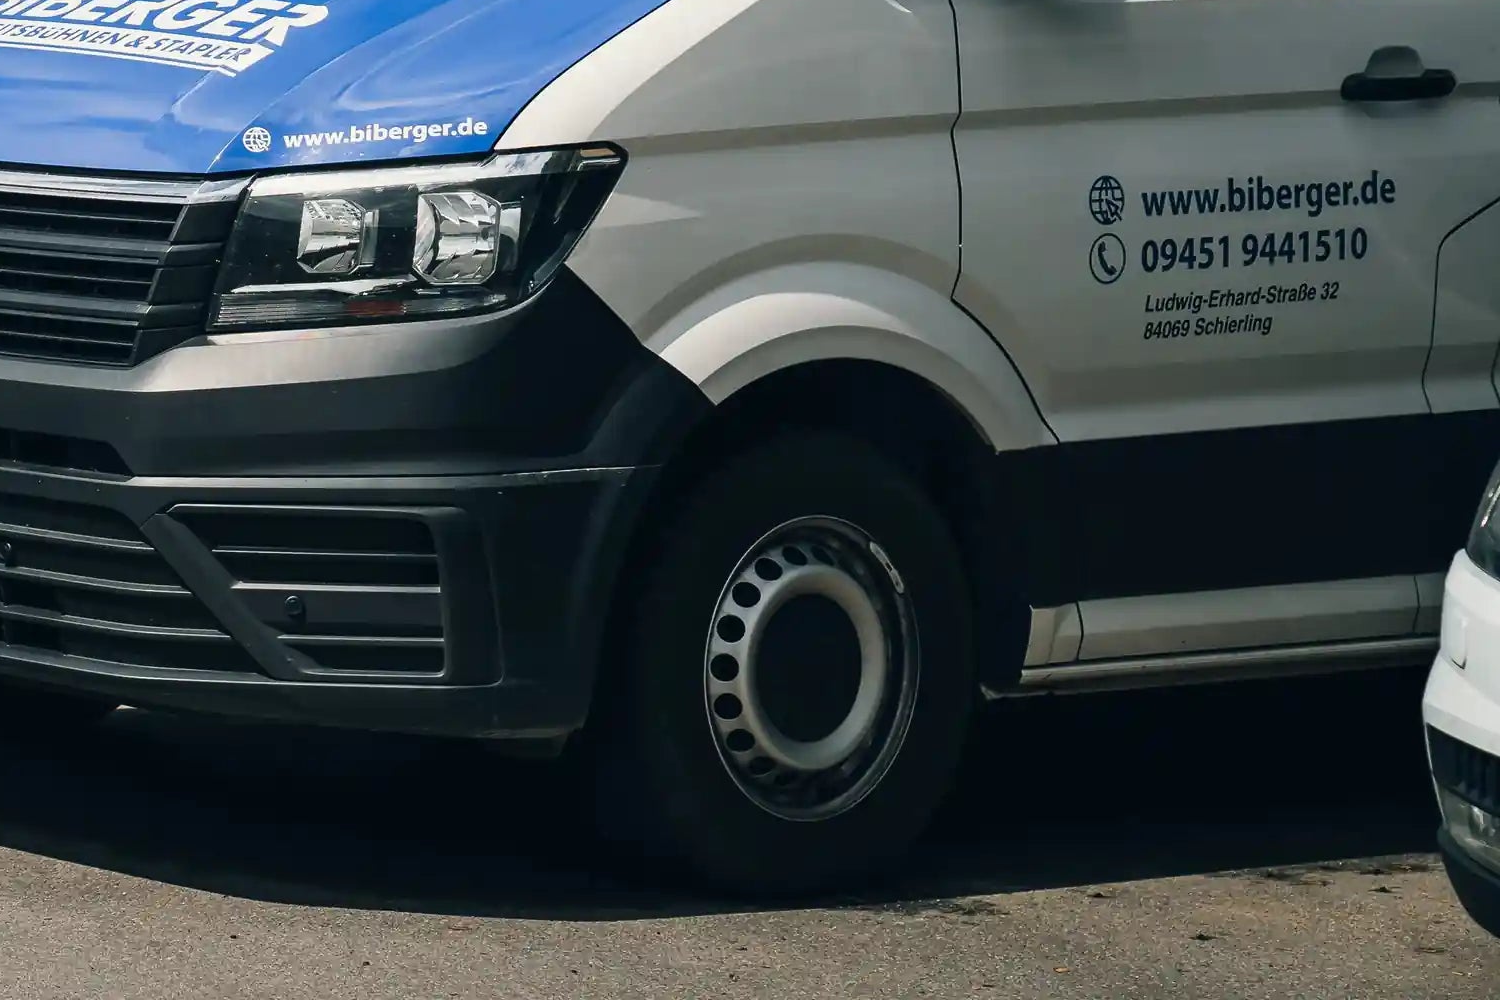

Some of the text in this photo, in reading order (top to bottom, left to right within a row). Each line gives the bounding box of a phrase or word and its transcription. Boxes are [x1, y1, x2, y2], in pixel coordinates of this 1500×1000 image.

[128, 35, 143, 49] &
[145, 36, 252, 63] STAPLER
[283, 117, 488, 148] www.biberger.de
[1141, 169, 1396, 218] www.biberger.de
[1141, 227, 1368, 273] 09451 9441510
[1144, 281, 1340, 314] Ludwig-Erhard-Straße 32
[1143, 314, 1274, 340] 84069 Schierling
